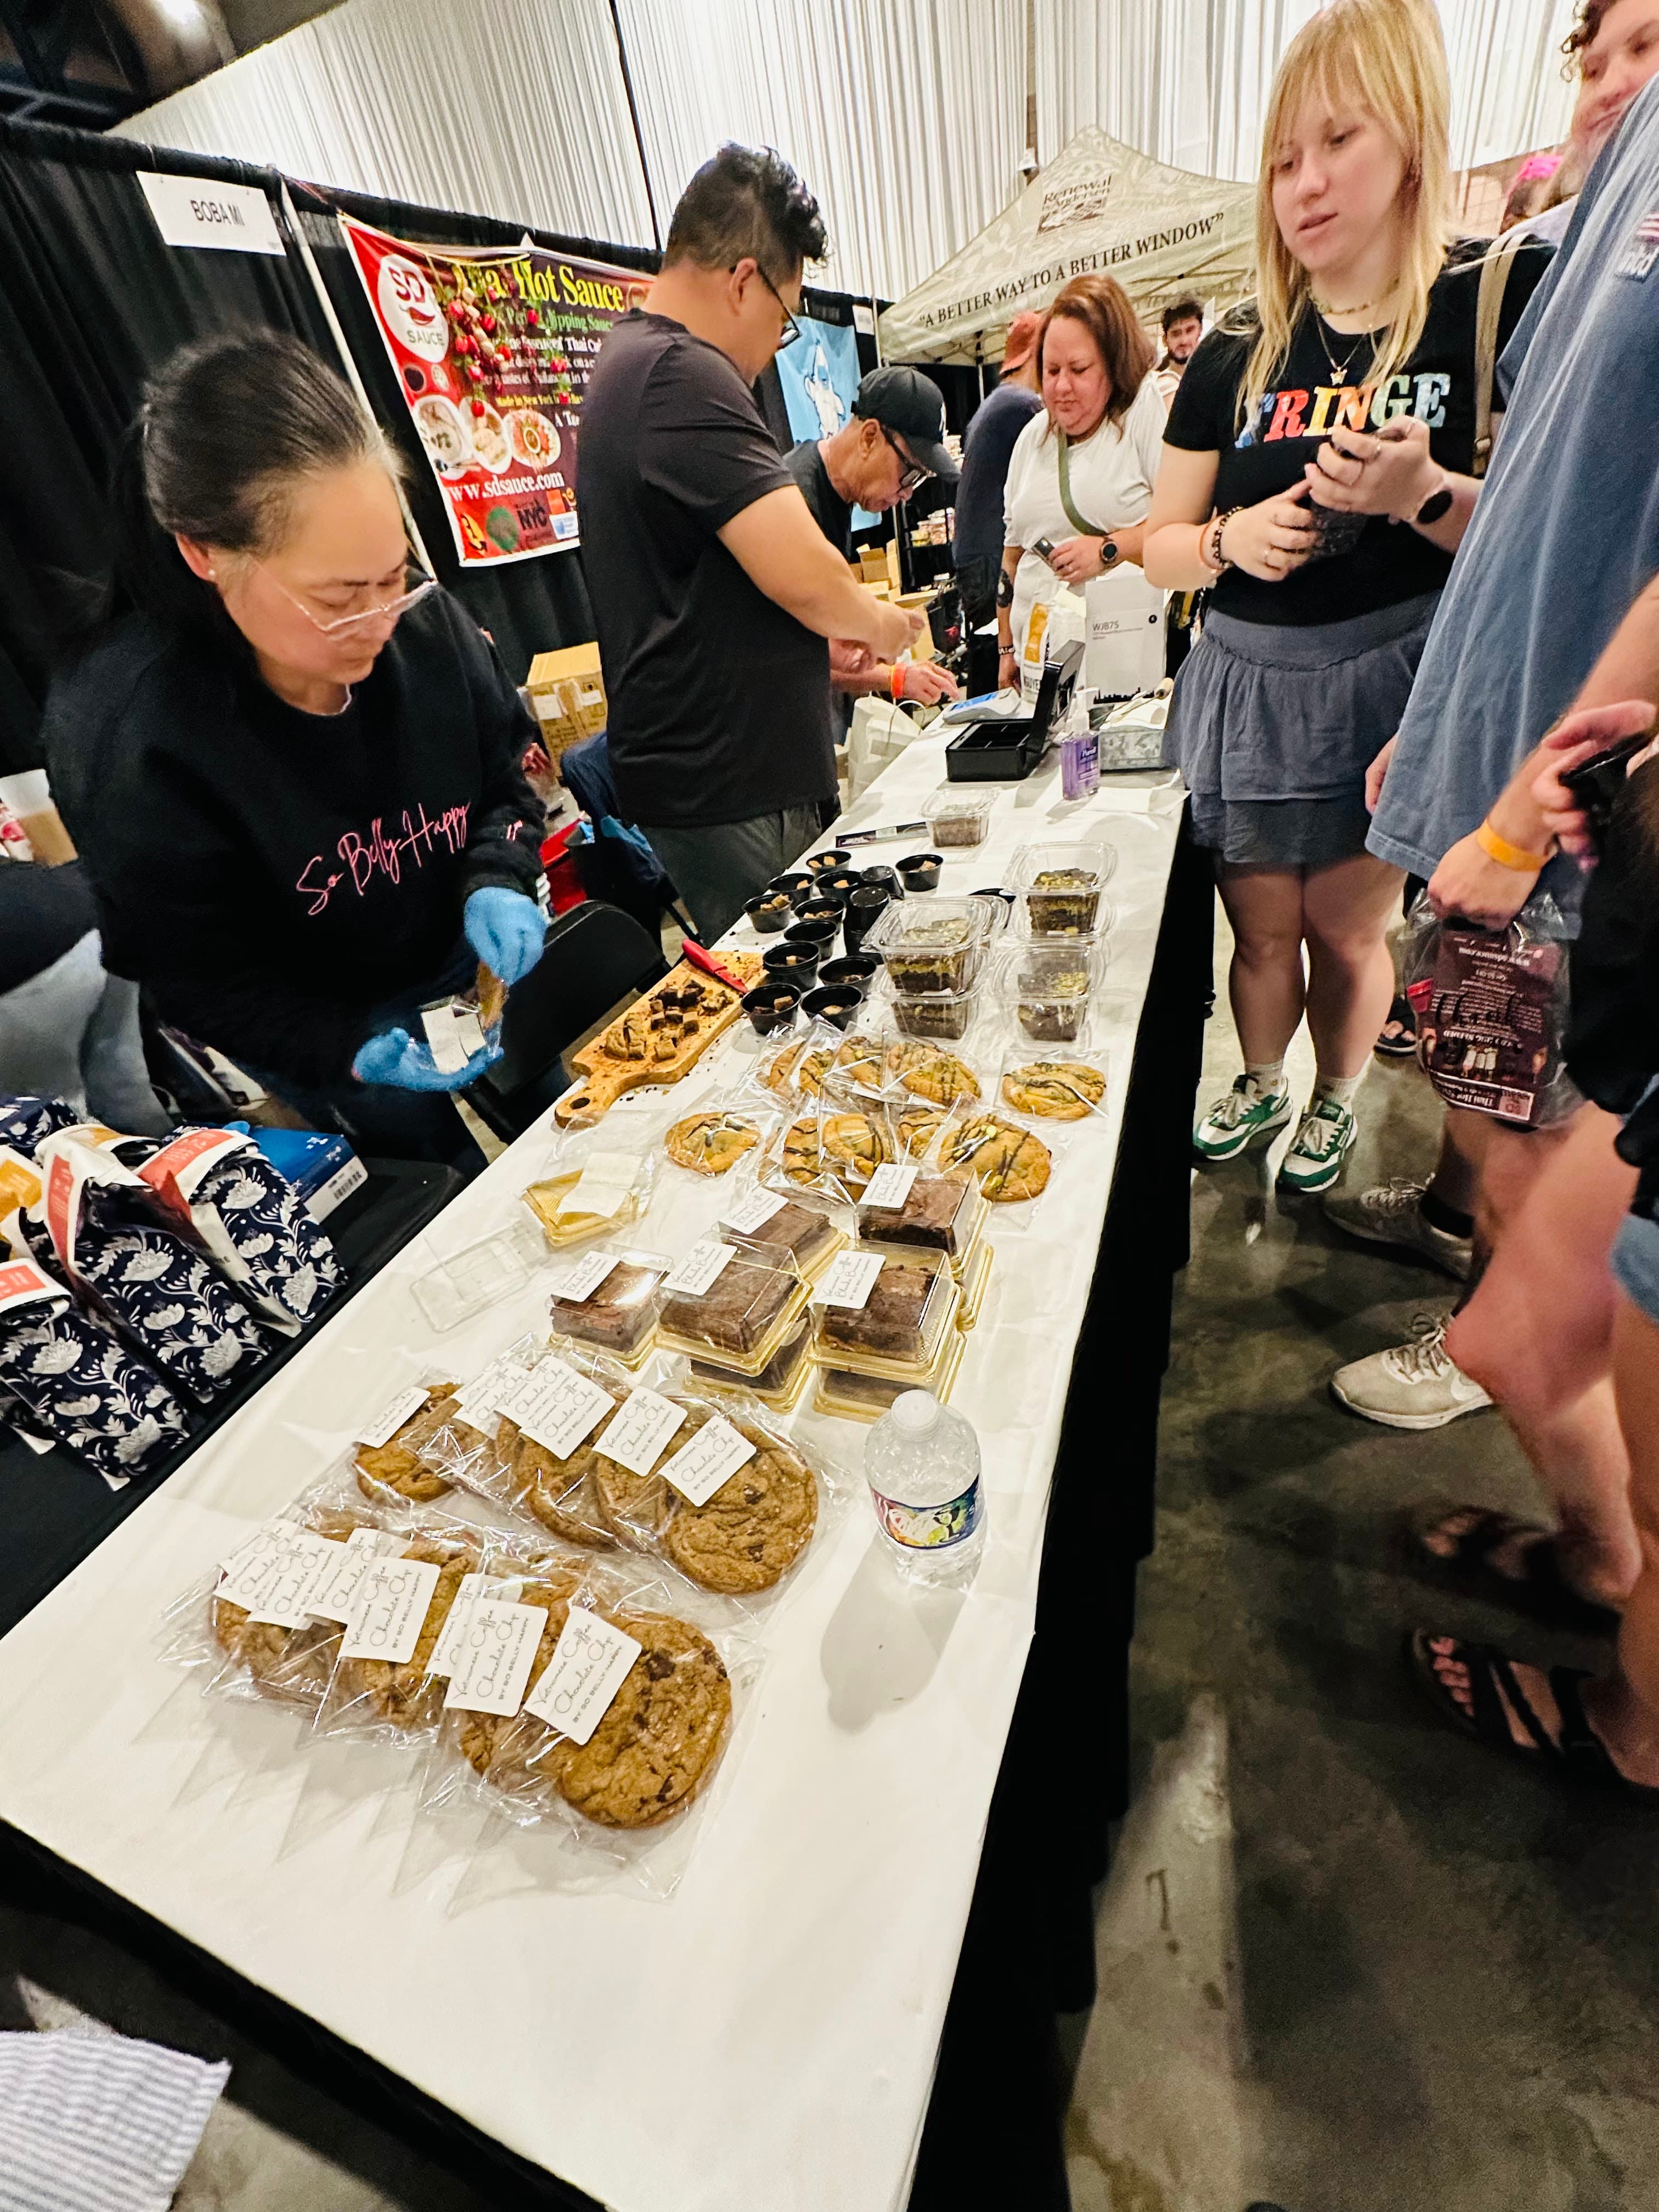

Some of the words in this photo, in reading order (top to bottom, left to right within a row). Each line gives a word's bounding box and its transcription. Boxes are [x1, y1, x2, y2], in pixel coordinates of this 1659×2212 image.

[1044, 176, 1111, 205] Renewal
[1054, 188, 1110, 211] Andersen
[190, 200, 228, 223] BOBA
[388, 267, 426, 303] SD
[937, 292, 993, 325] BETTER
[995, 279, 1028, 303] WAY
[1030, 269, 1051, 290] TO
[1054, 266, 1066, 281] A
[1070, 245, 1133, 277] BETTER
[1136, 212, 1225, 254] WINDOW”
[511, 261, 561, 303] Hot
[558, 264, 625, 313] Sauce
[407, 330, 445, 346] SAUCE
[555, 411, 563, 427] A
[517, 506, 548, 531] NYC
[1023, 675, 1041, 691] NGUYE
[296, 855, 345, 916] So
[337, 816, 401, 896] Belly
[399, 802, 471, 867] Happy
[554, 1381, 579, 1403] Coffee
[624, 1395, 648, 1419] Coffee
[544, 1406, 578, 1439] Chocolate
[573, 1390, 594, 1407] Chip
[620, 1421, 651, 1455] Chocolate
[645, 1404, 665, 1421] Chip
[693, 1424, 720, 1446] Coffee
[681, 1453, 716, 1482] Chocolate
[713, 1436, 735, 1453] Chip
[275, 1543, 304, 1573] Coffee
[274, 1570, 309, 1614] Chocolate
[301, 1547, 326, 1569] Chip
[331, 1565, 368, 1608] Chocolate
[362, 1566, 388, 1601] Coffee
[370, 1596, 400, 1646] Chocolate
[388, 1568, 413, 1595] Chip
[470, 1609, 496, 1648] Coffee
[561, 1623, 592, 1658] Coffee
[476, 1643, 507, 1698] Chocolate
[495, 1612, 520, 1641] Chip
[554, 1664, 595, 1714] Chocolate
[587, 1635, 613, 1662] Chip
